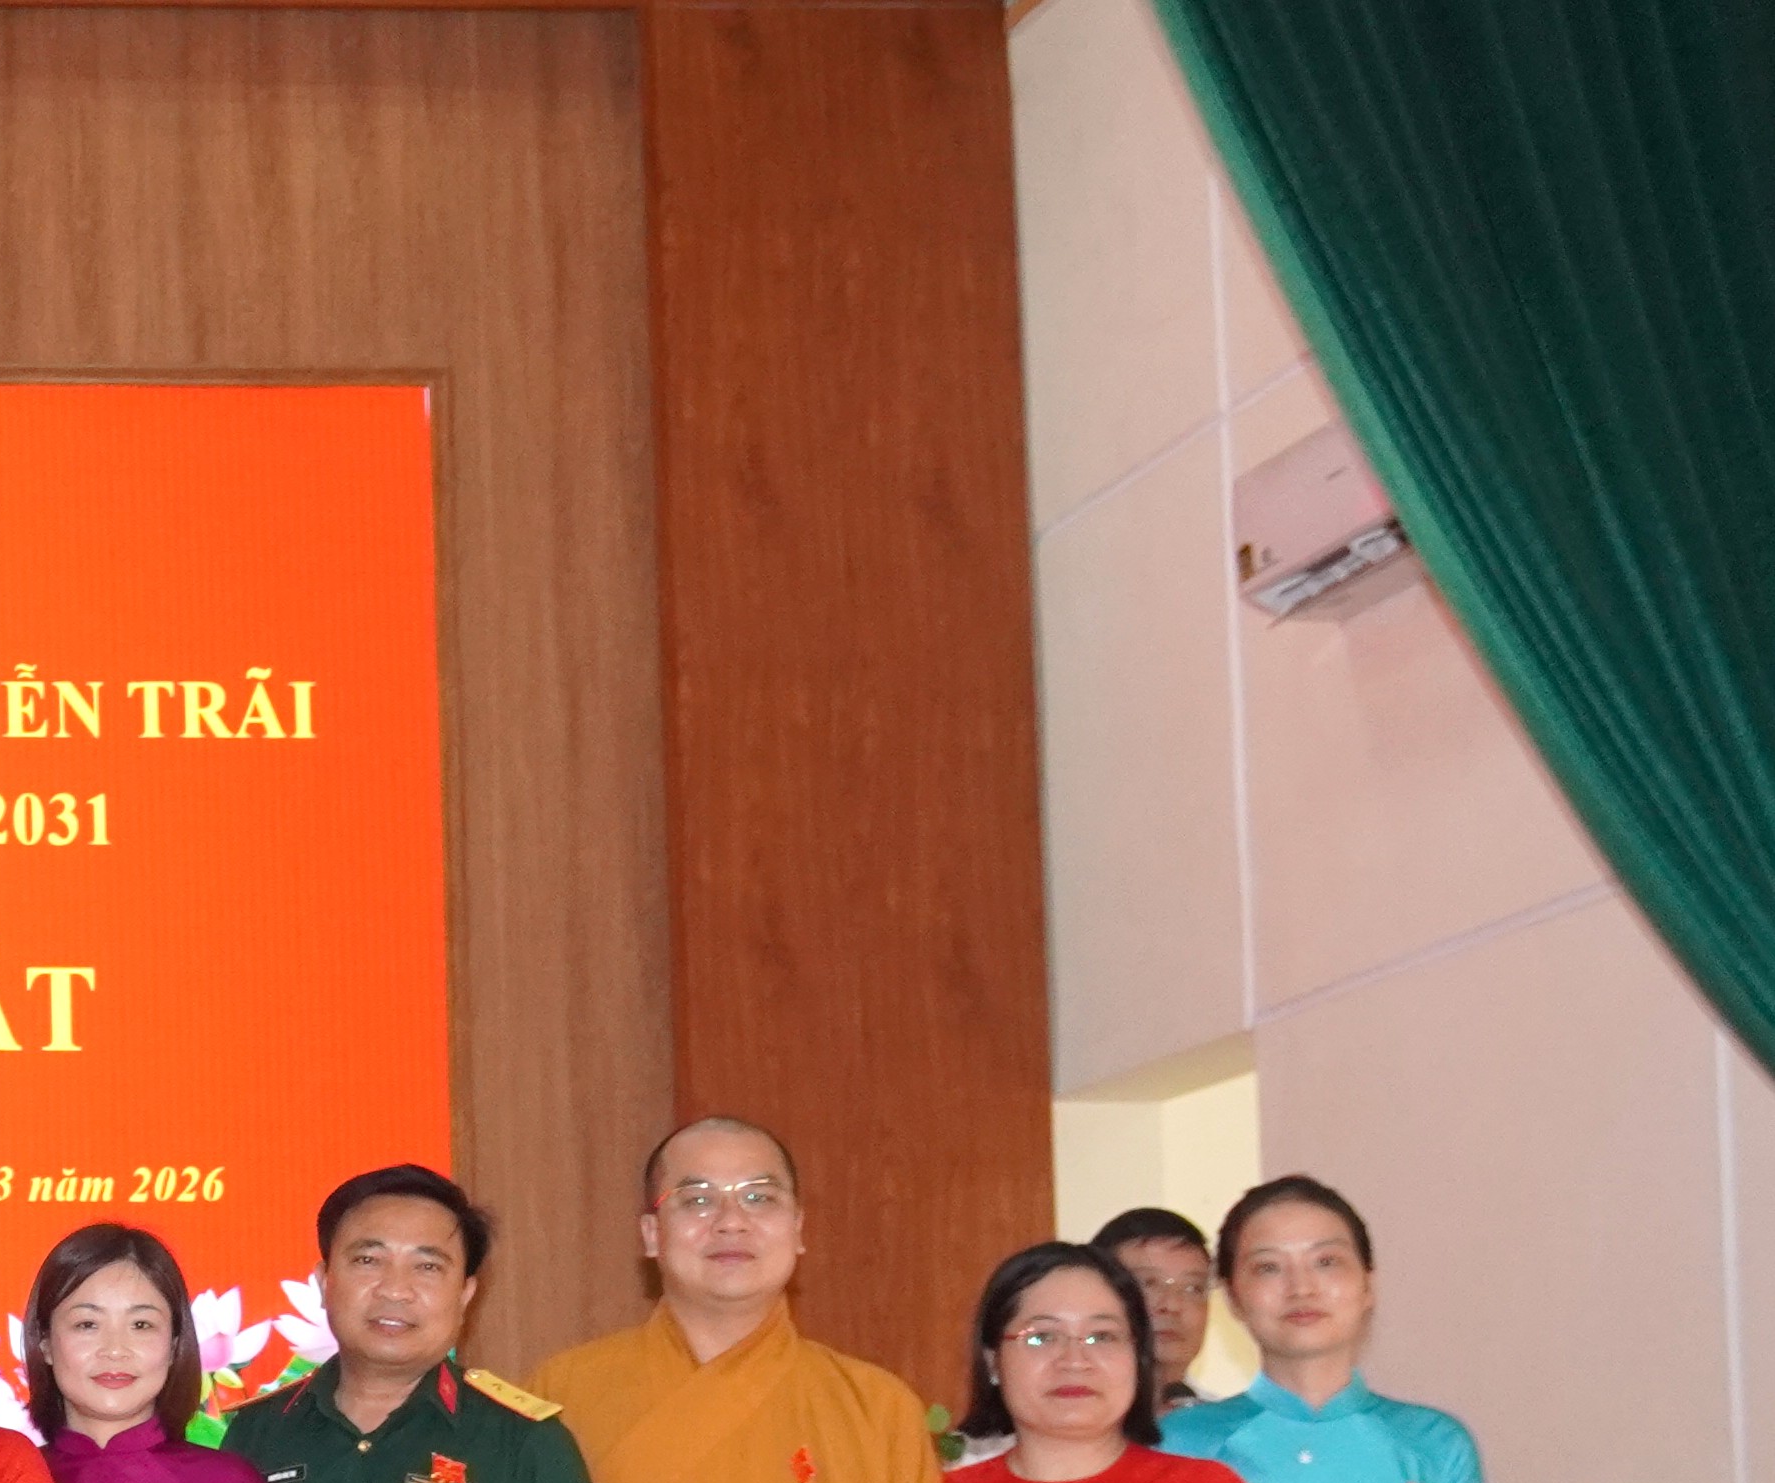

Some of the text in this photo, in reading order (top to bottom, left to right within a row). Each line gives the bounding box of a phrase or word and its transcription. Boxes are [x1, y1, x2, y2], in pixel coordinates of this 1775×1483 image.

[126, 666, 315, 739] TRÃI
[28, 1165, 115, 1204] năm
[128, 1165, 224, 1204] 2026
